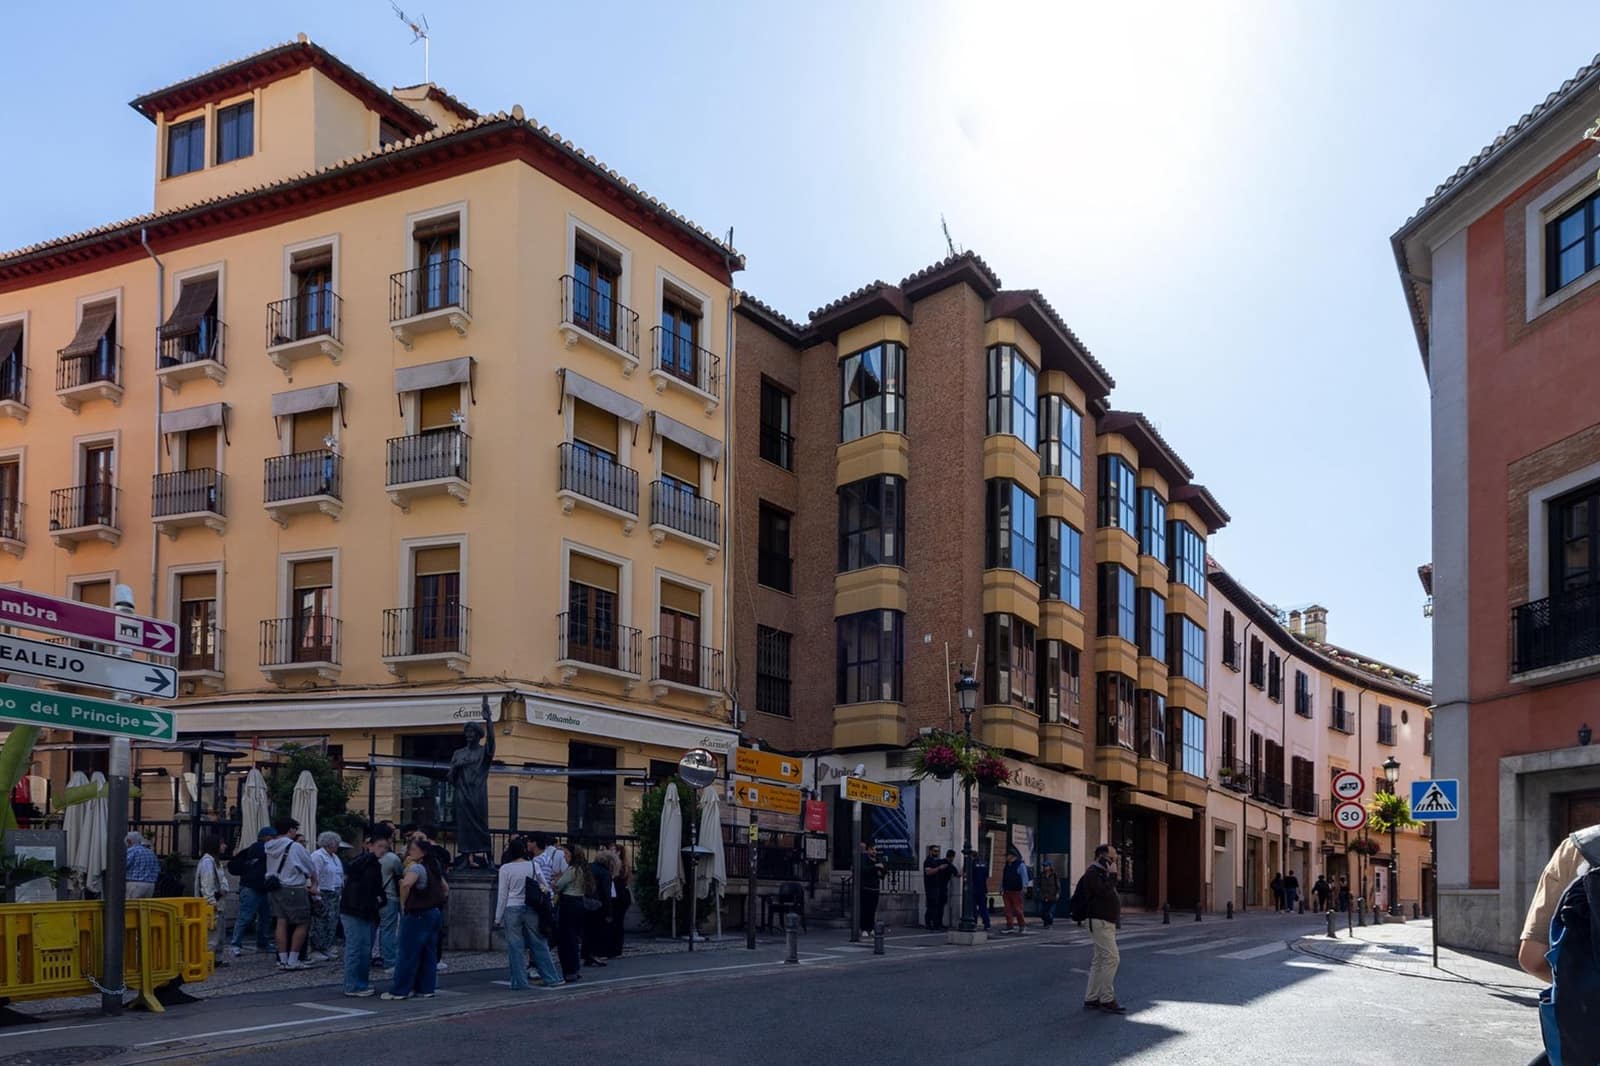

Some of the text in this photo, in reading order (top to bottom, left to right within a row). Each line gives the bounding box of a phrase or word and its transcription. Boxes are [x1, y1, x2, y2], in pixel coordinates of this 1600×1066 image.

[2, 600, 57, 622] mbra
[0, 645, 84, 672] EALEJO
[30, 701, 60, 716] del
[453, 706, 487, 720] Carm
[545, 712, 581, 726] Alhambra
[1341, 811, 1360, 821] 30
